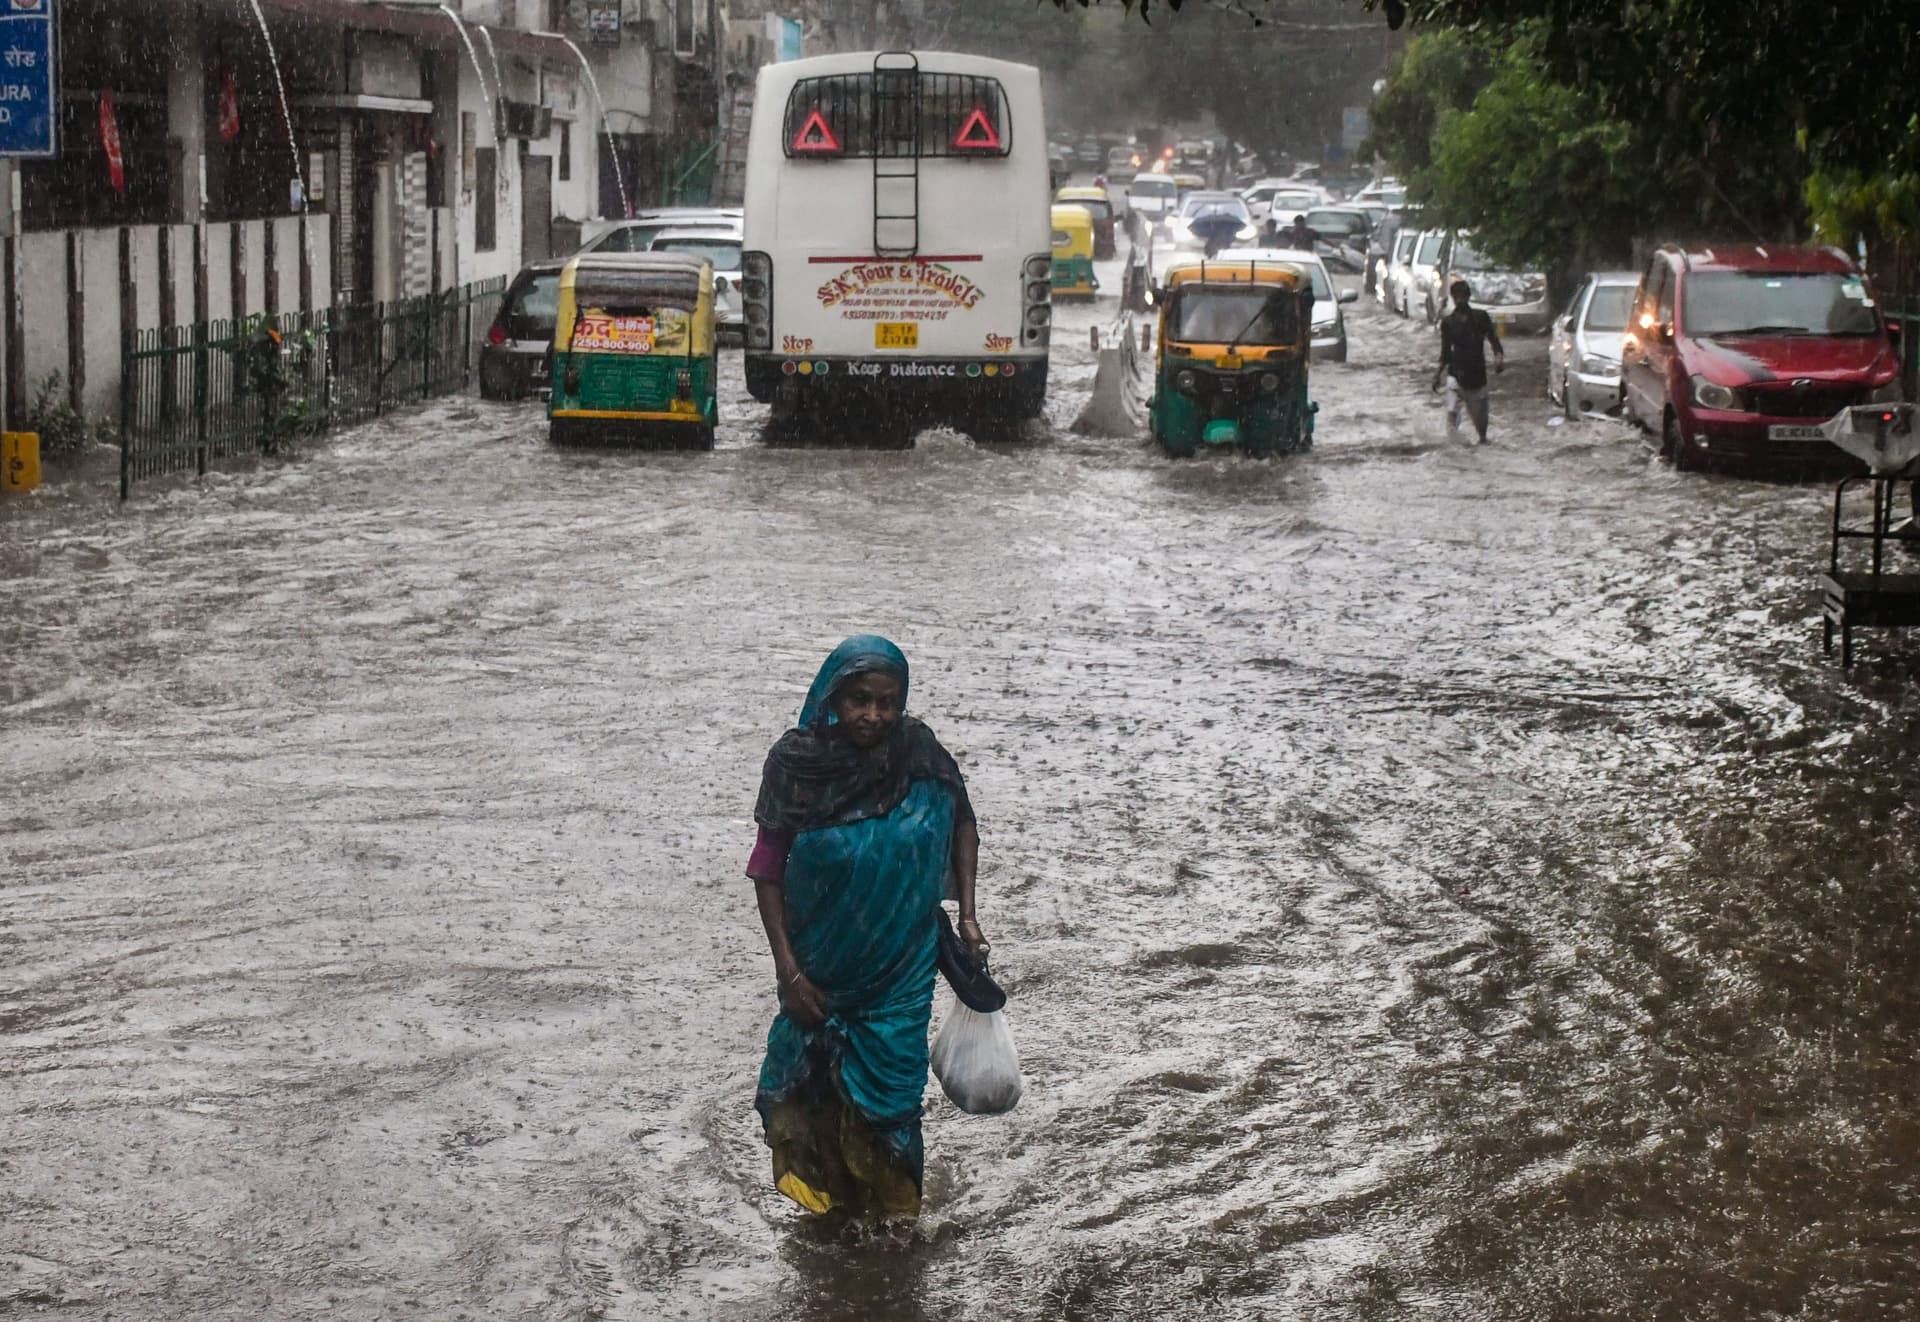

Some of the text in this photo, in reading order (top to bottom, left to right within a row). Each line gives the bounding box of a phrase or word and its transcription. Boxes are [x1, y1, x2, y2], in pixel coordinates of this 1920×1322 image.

[4, 45, 36, 68] रोड
[852, 263, 895, 283] Tour
[898, 264, 913, 281] &
[916, 262, 979, 310] Travels
[782, 335, 813, 351] Stop
[984, 333, 1013, 351] Stop
[848, 361, 955, 376] Keep Distance
